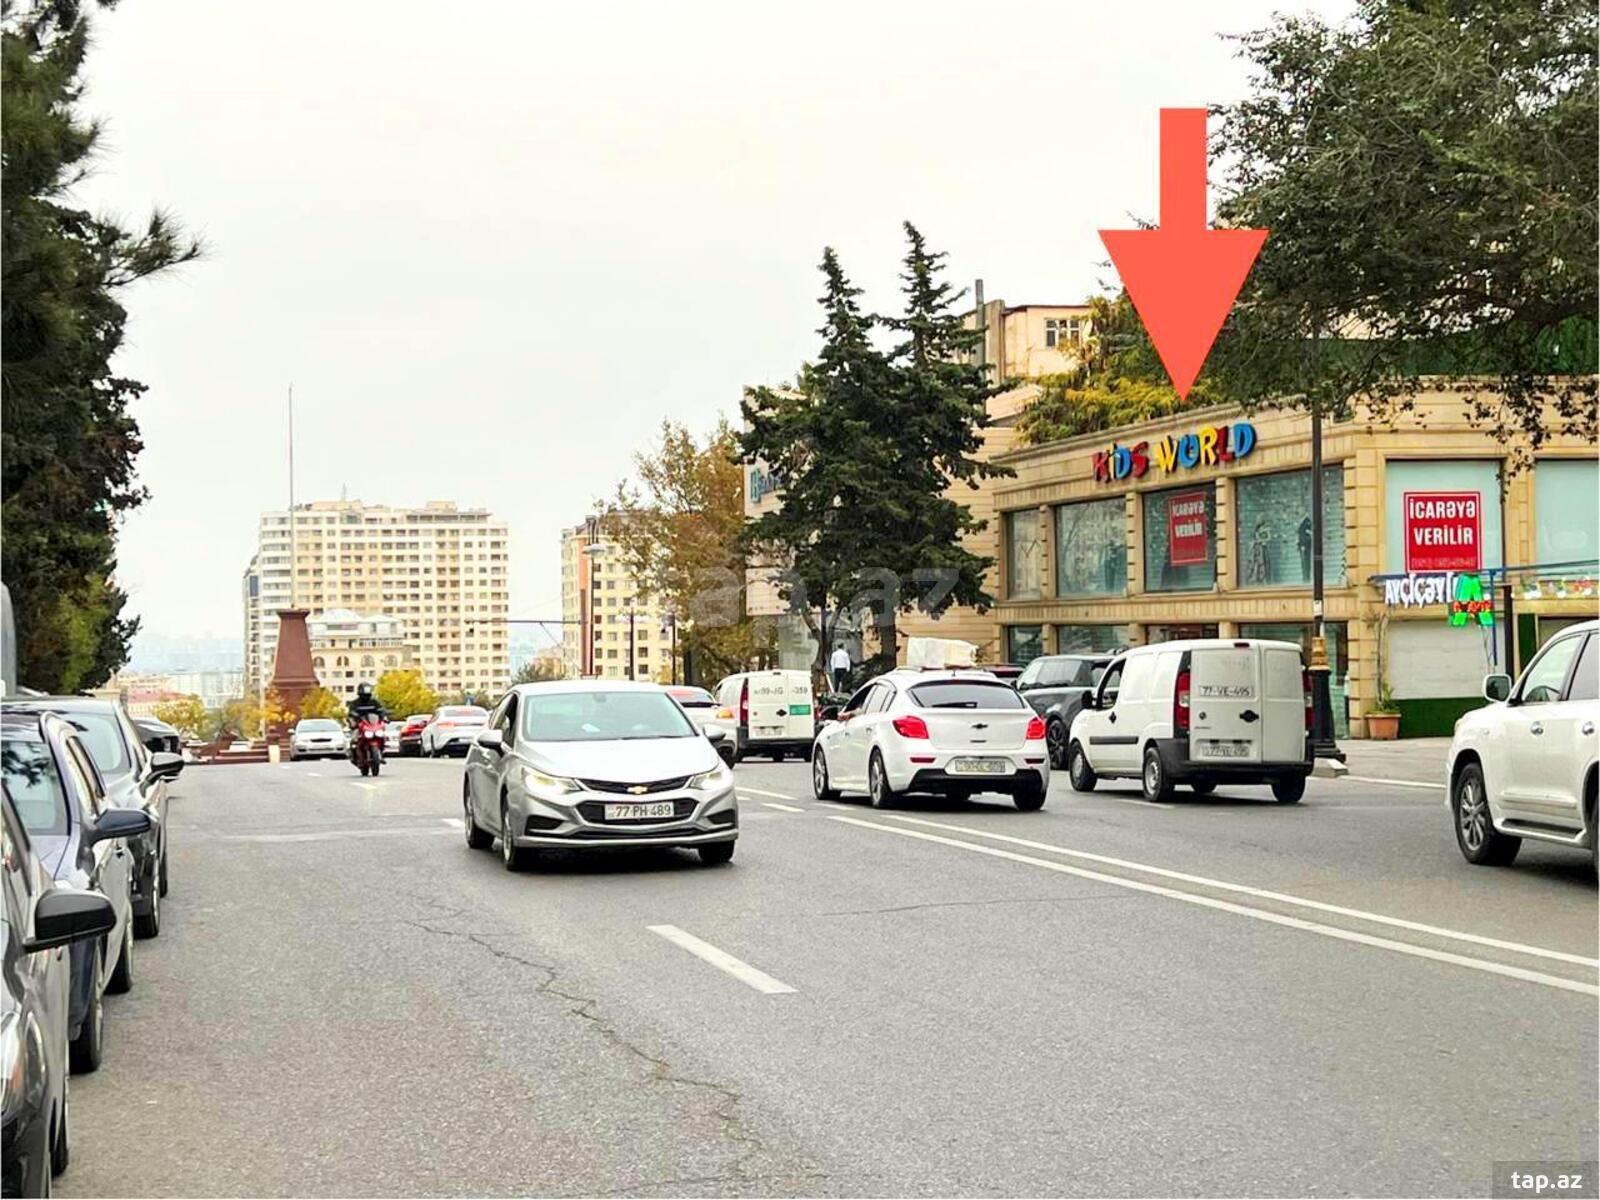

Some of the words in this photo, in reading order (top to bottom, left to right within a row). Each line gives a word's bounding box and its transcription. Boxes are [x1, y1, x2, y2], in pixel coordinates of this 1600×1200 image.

[1156, 422, 1257, 474] WORLD
[1409, 498, 1476, 519] İCARƏYƏ
[1414, 525, 1473, 545] VERİLİR
[616, 806, 630, 817] 77
[633, 805, 648, 816] PH
[651, 804, 671, 816] 489
